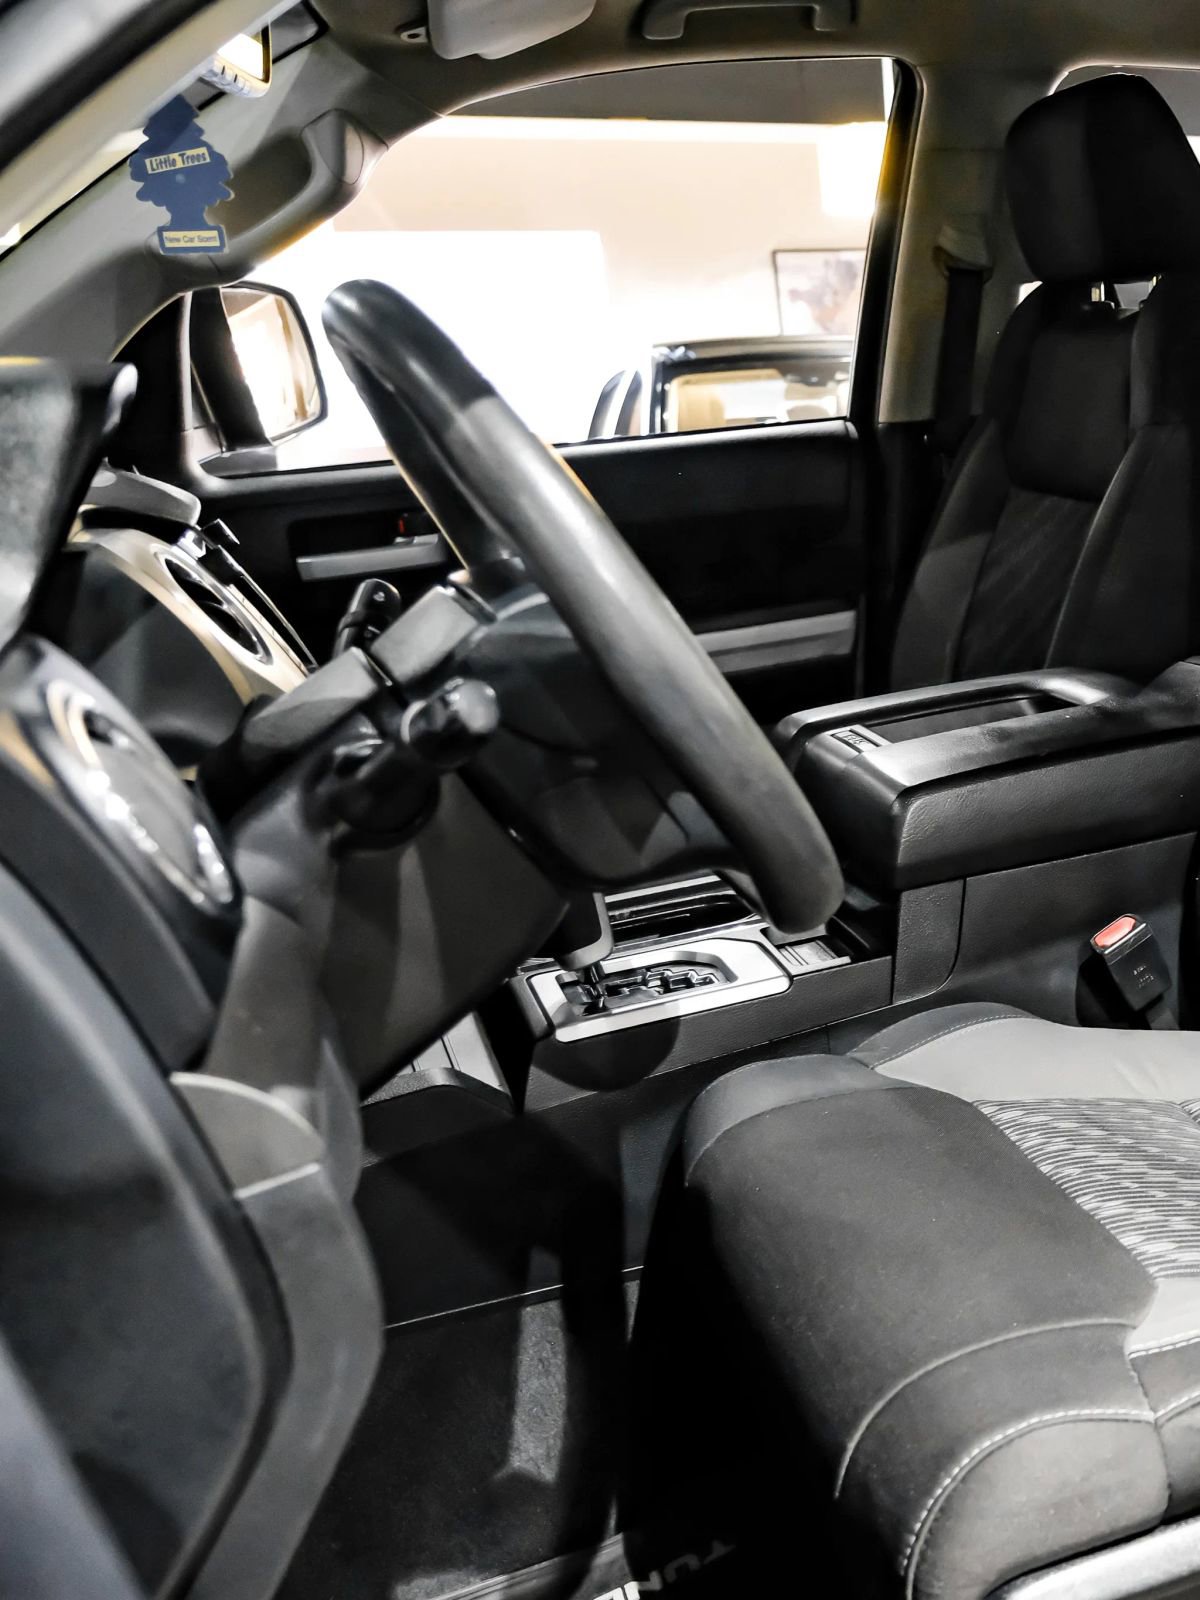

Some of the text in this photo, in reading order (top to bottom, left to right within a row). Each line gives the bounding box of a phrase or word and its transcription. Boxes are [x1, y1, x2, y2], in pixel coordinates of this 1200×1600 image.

[150, 152, 207, 171] Little Trees
[182, 235, 195, 243] Car
